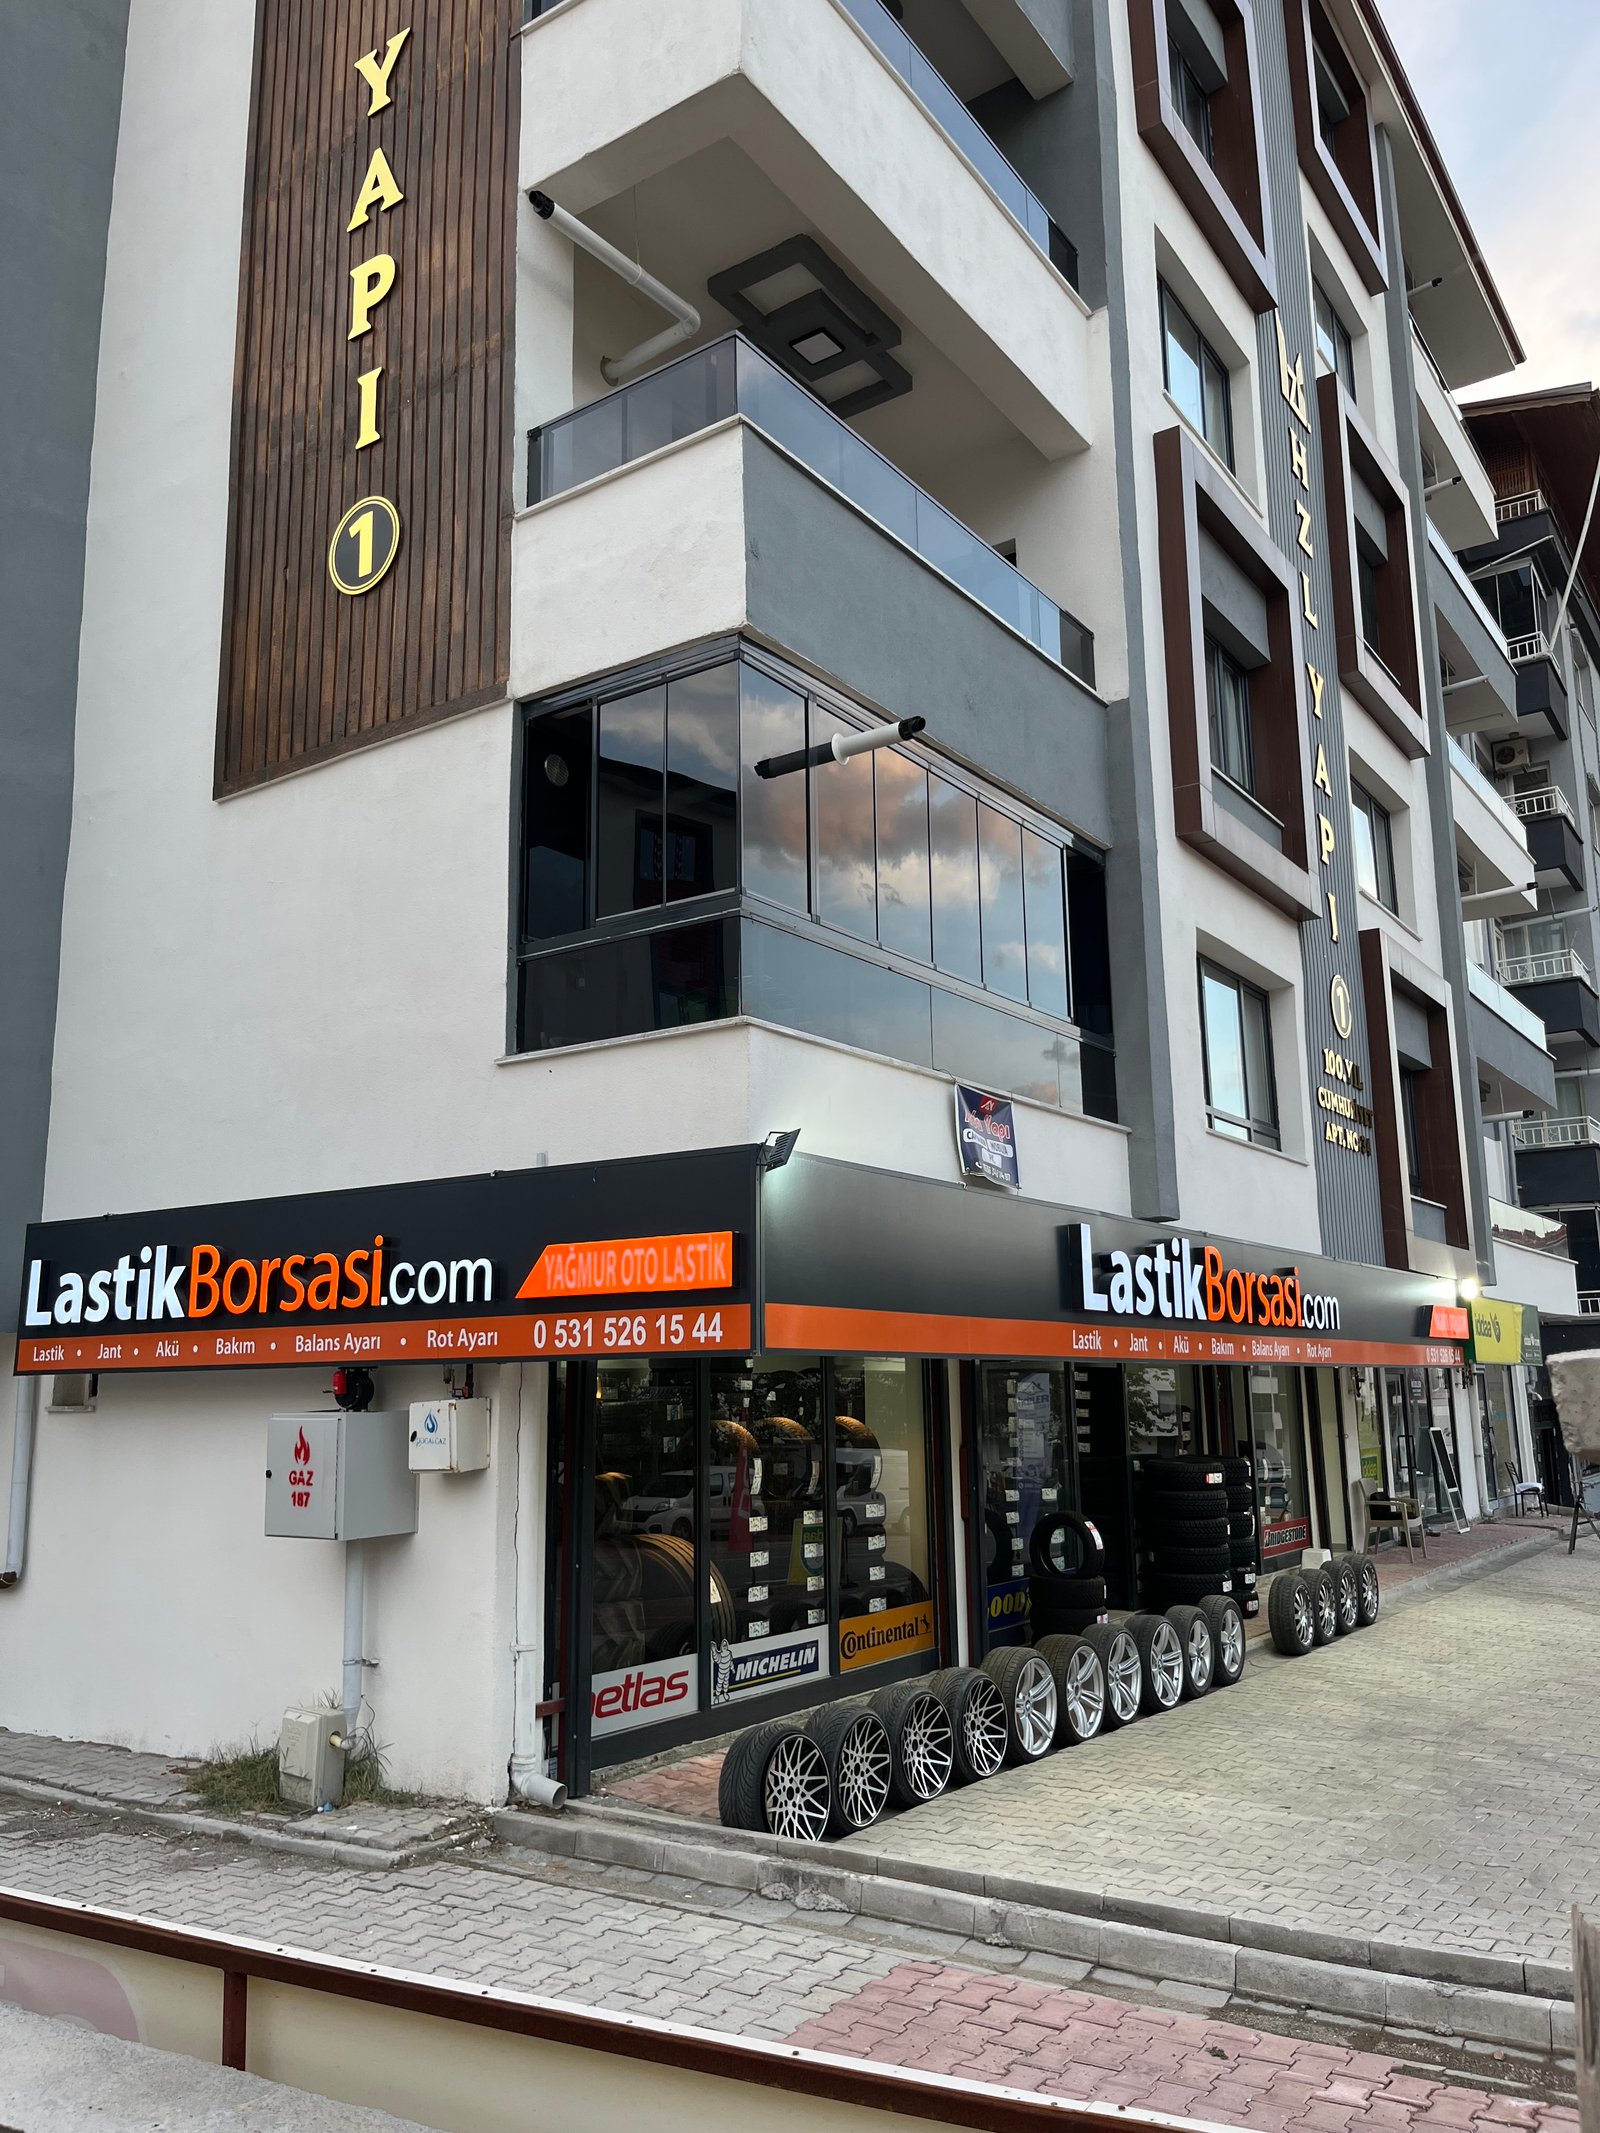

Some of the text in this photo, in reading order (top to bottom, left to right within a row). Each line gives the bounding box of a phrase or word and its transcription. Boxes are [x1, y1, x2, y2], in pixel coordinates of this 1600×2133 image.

[346, 26, 411, 450] YAPI
[348, 510, 375, 579] 1
[1306, 662, 1338, 943] YAPI
[25, 1234, 492, 1327] LastikBorsasi.com
[543, 1234, 727, 1291] YAĞMUR OTO LASTİK
[1080, 1223, 1341, 1330] LastikBorsasi.com
[33, 1328, 498, 1362] Lastik Jant Akü Bakım Balans Ayarı Rot Ayarı
[533, 1311, 723, 1349] 0 531 526 15 44
[1072, 1329, 1102, 1350] Lastik
[1129, 1332, 1149, 1352] Jant
[1173, 1335, 1190, 1353] Akü
[1211, 1337, 1234, 1355] Bakım
[1251, 1339, 1273, 1357] Balans
[1306, 1342, 1317, 1358] Rot
[288, 1470, 314, 1487] GAZ
[291, 1491, 311, 1508] 187
[1264, 1524, 1307, 1548] BRIDGESTONE
[839, 1615, 920, 1660] Continental
[735, 1646, 817, 1682] MICHELIN
[591, 1670, 690, 1719] etlas
